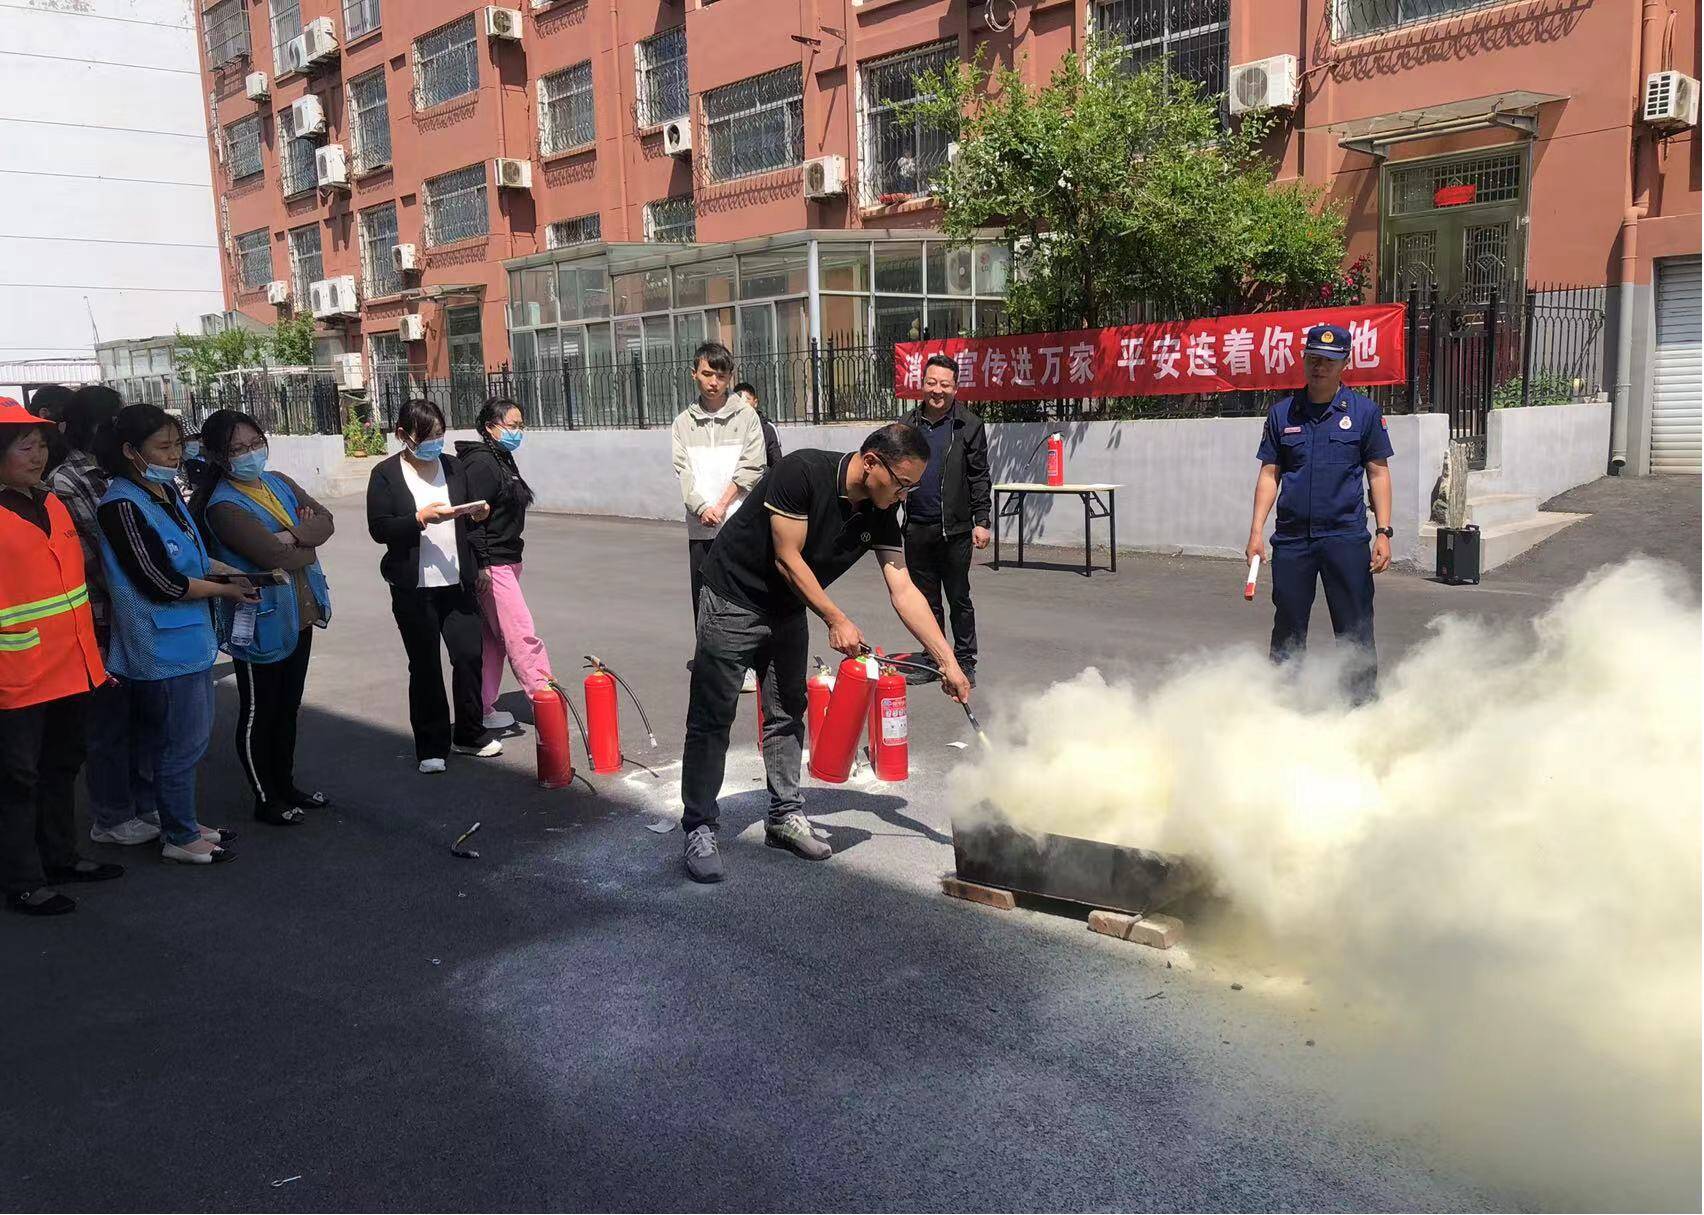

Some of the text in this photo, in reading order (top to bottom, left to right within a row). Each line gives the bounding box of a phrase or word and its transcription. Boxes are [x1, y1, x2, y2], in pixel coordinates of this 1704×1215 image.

[904, 319, 1380, 390] 消宣传进万家 平安连着你他
